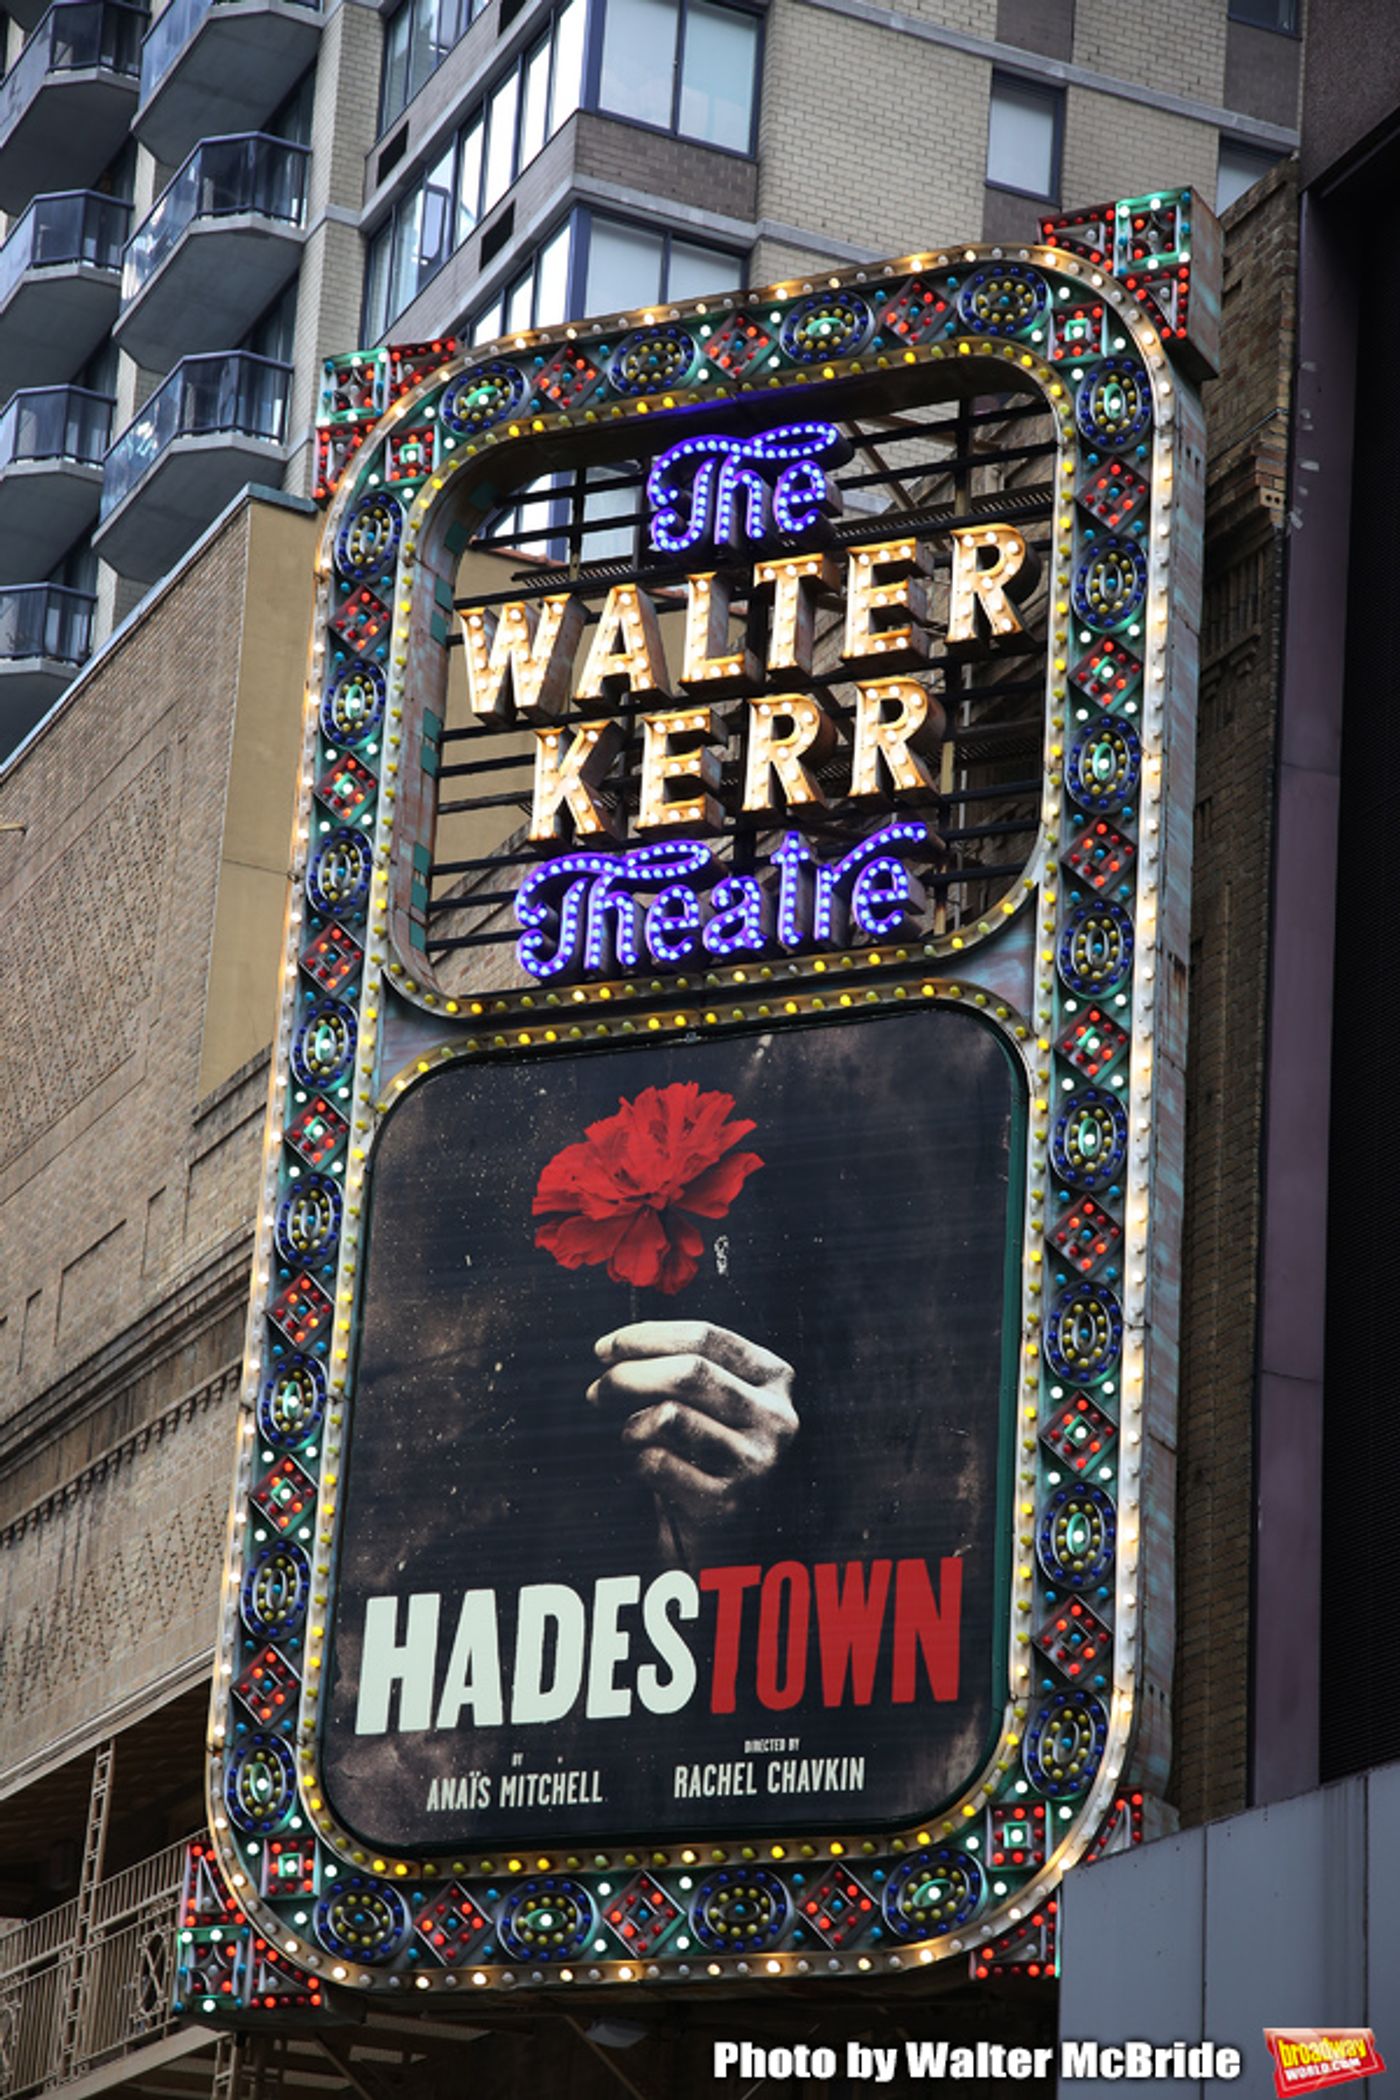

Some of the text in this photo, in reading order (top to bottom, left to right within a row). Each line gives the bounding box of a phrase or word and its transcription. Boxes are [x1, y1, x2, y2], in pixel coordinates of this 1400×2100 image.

[647, 420, 838, 553] The
[460, 523, 1032, 716] WALTER
[527, 677, 935, 842] KERR
[515, 822, 927, 978] Theatre
[355, 1557, 963, 1735] HADESTOWN
[426, 1770, 603, 1812] ANAÏS MITCHELL
[511, 1753, 523, 1766] BY
[674, 1757, 865, 1798] RACHEL CHAVKIN
[744, 1737, 800, 1754] DIRECTED BY
